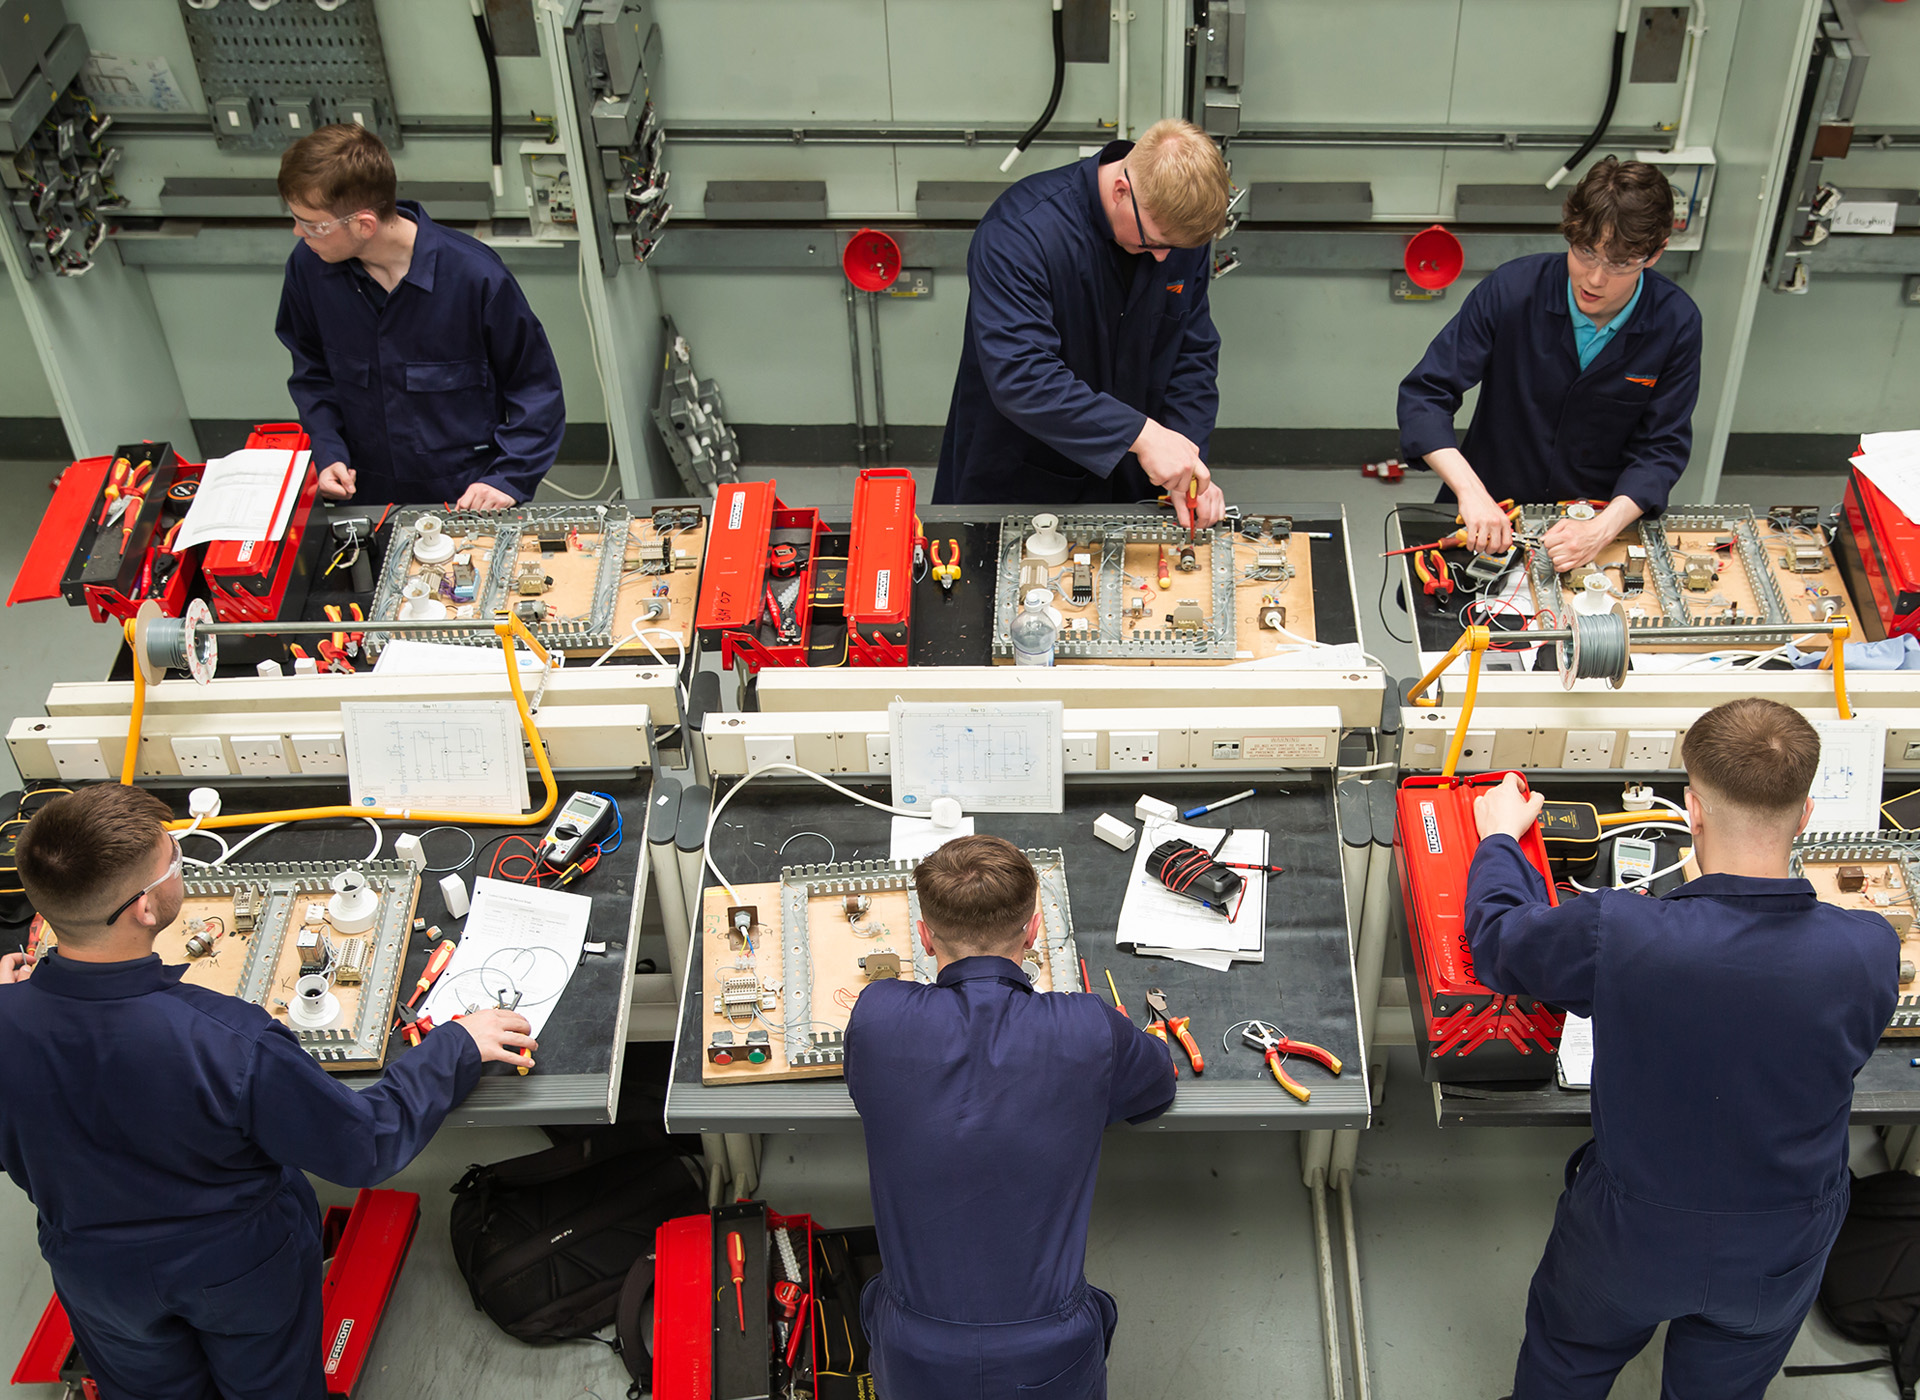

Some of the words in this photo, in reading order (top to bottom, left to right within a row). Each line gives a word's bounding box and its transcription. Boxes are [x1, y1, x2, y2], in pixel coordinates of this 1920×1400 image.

[720, 591, 732, 604] 07
[1424, 816, 1441, 853] FACOM
[332, 1321, 352, 1358] FACOM
